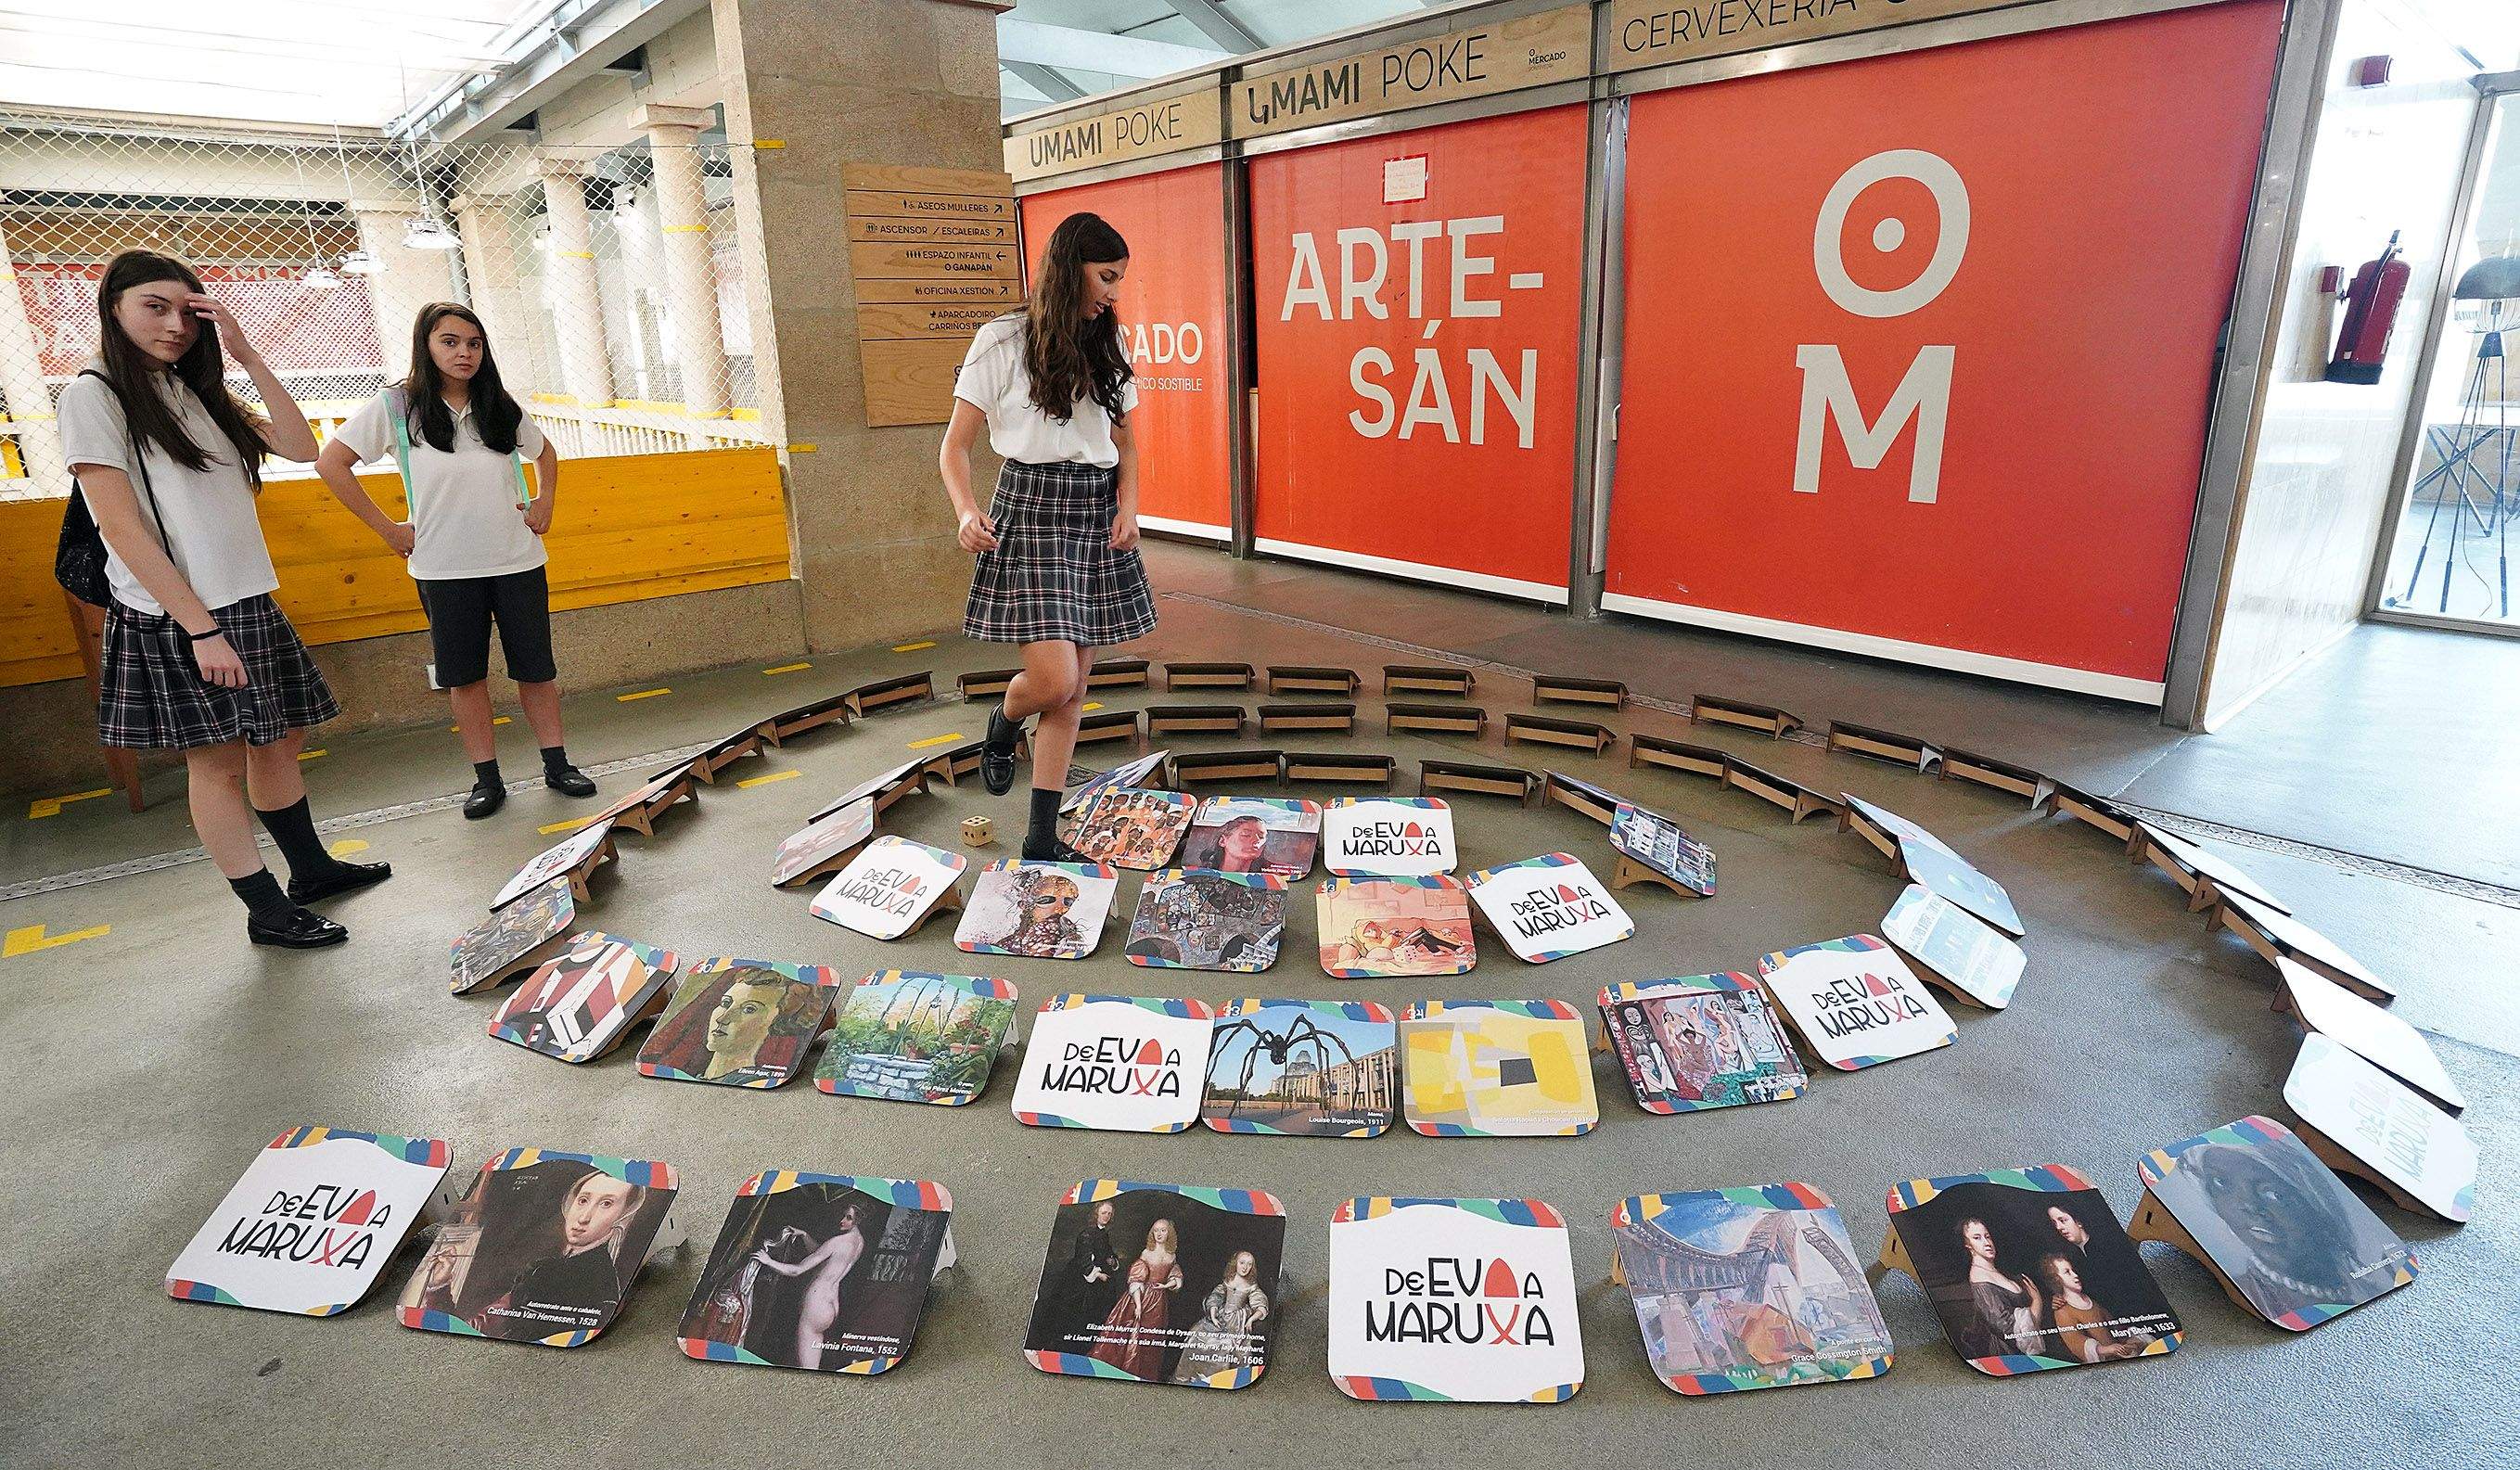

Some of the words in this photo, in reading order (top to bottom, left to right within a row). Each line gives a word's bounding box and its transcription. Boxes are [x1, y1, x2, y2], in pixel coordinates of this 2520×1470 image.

[1382, 34, 1488, 97] POKE
[1529, 51, 1567, 65] MERCADO
[1030, 121, 1102, 168] UMAMI
[1116, 103, 1183, 150] POKE
[917, 201, 946, 211] ASEOS
[947, 202, 989, 213] MULLERES
[880, 224, 927, 236] ASCENSOR
[941, 226, 991, 236] ESCALEIRAS
[923, 250, 955, 260] ESPAZO
[956, 251, 992, 261] INFANTIL
[944, 262, 952, 271] O
[1280, 215, 1543, 322] ARTE-
[924, 286, 959, 295] OFICINA
[938, 310, 996, 319] APARCADOIRO
[928, 322, 971, 331] CARRIÑOS
[1158, 377, 1203, 391] SOSTIBLE
[1349, 319, 1538, 449] SÁN
[1793, 344, 1956, 505] M
[1343, 839, 1441, 855] MARUXA
[836, 878, 915, 918] MARUXA
[1512, 900, 1611, 939] MARUXA
[1047, 1001, 1065, 1012] 32
[1222, 1005, 1240, 1016] 33
[1815, 994, 1928, 1040] MARUXA
[1041, 1063, 1180, 1097] MARUXA
[950, 1087, 973, 1095] Moreno
[1332, 1117, 1366, 1126] Bourgeois,
[216, 1217, 373, 1270] MARUXA
[527, 1300, 560, 1310] Autorretrato
[487, 1306, 522, 1318] Catharina
[523, 1310, 537, 1320] Van
[537, 1311, 577, 1325] Hemessen,
[579, 1317, 598, 1326] 1528
[1366, 1300, 1554, 1346] MARUXA
[1086, 1323, 1114, 1332] Elizabeth
[1139, 1327, 1166, 1336] Condesa
[1166, 1327, 1175, 1336] de
[1247, 1333, 1266, 1342] home,
[2059, 1324, 2078, 1333] home,
[2077, 1322, 2099, 1331] Charles
[2110, 1327, 2132, 1339] Mary
[2132, 1324, 2156, 1336] Beale,
[2156, 1322, 2176, 1332] 1633
[842, 1332, 867, 1341] Minerva
[1073, 1334, 1093, 1342] Lionel
[1093, 1336, 1128, 1345] Tollemache
[1168, 1340, 1196, 1349] Margaret
[812, 1340, 840, 1350] Lavinia
[840, 1342, 875, 1354] Fontana,
[877, 1346, 898, 1355] 1552
[1791, 1354, 1815, 1362] Grace
[1862, 1345, 1887, 1355] Smith
[1189, 1353, 1210, 1361] Joan
[1211, 1353, 1241, 1364] Carlile,
[1243, 1356, 1264, 1365] 1606
